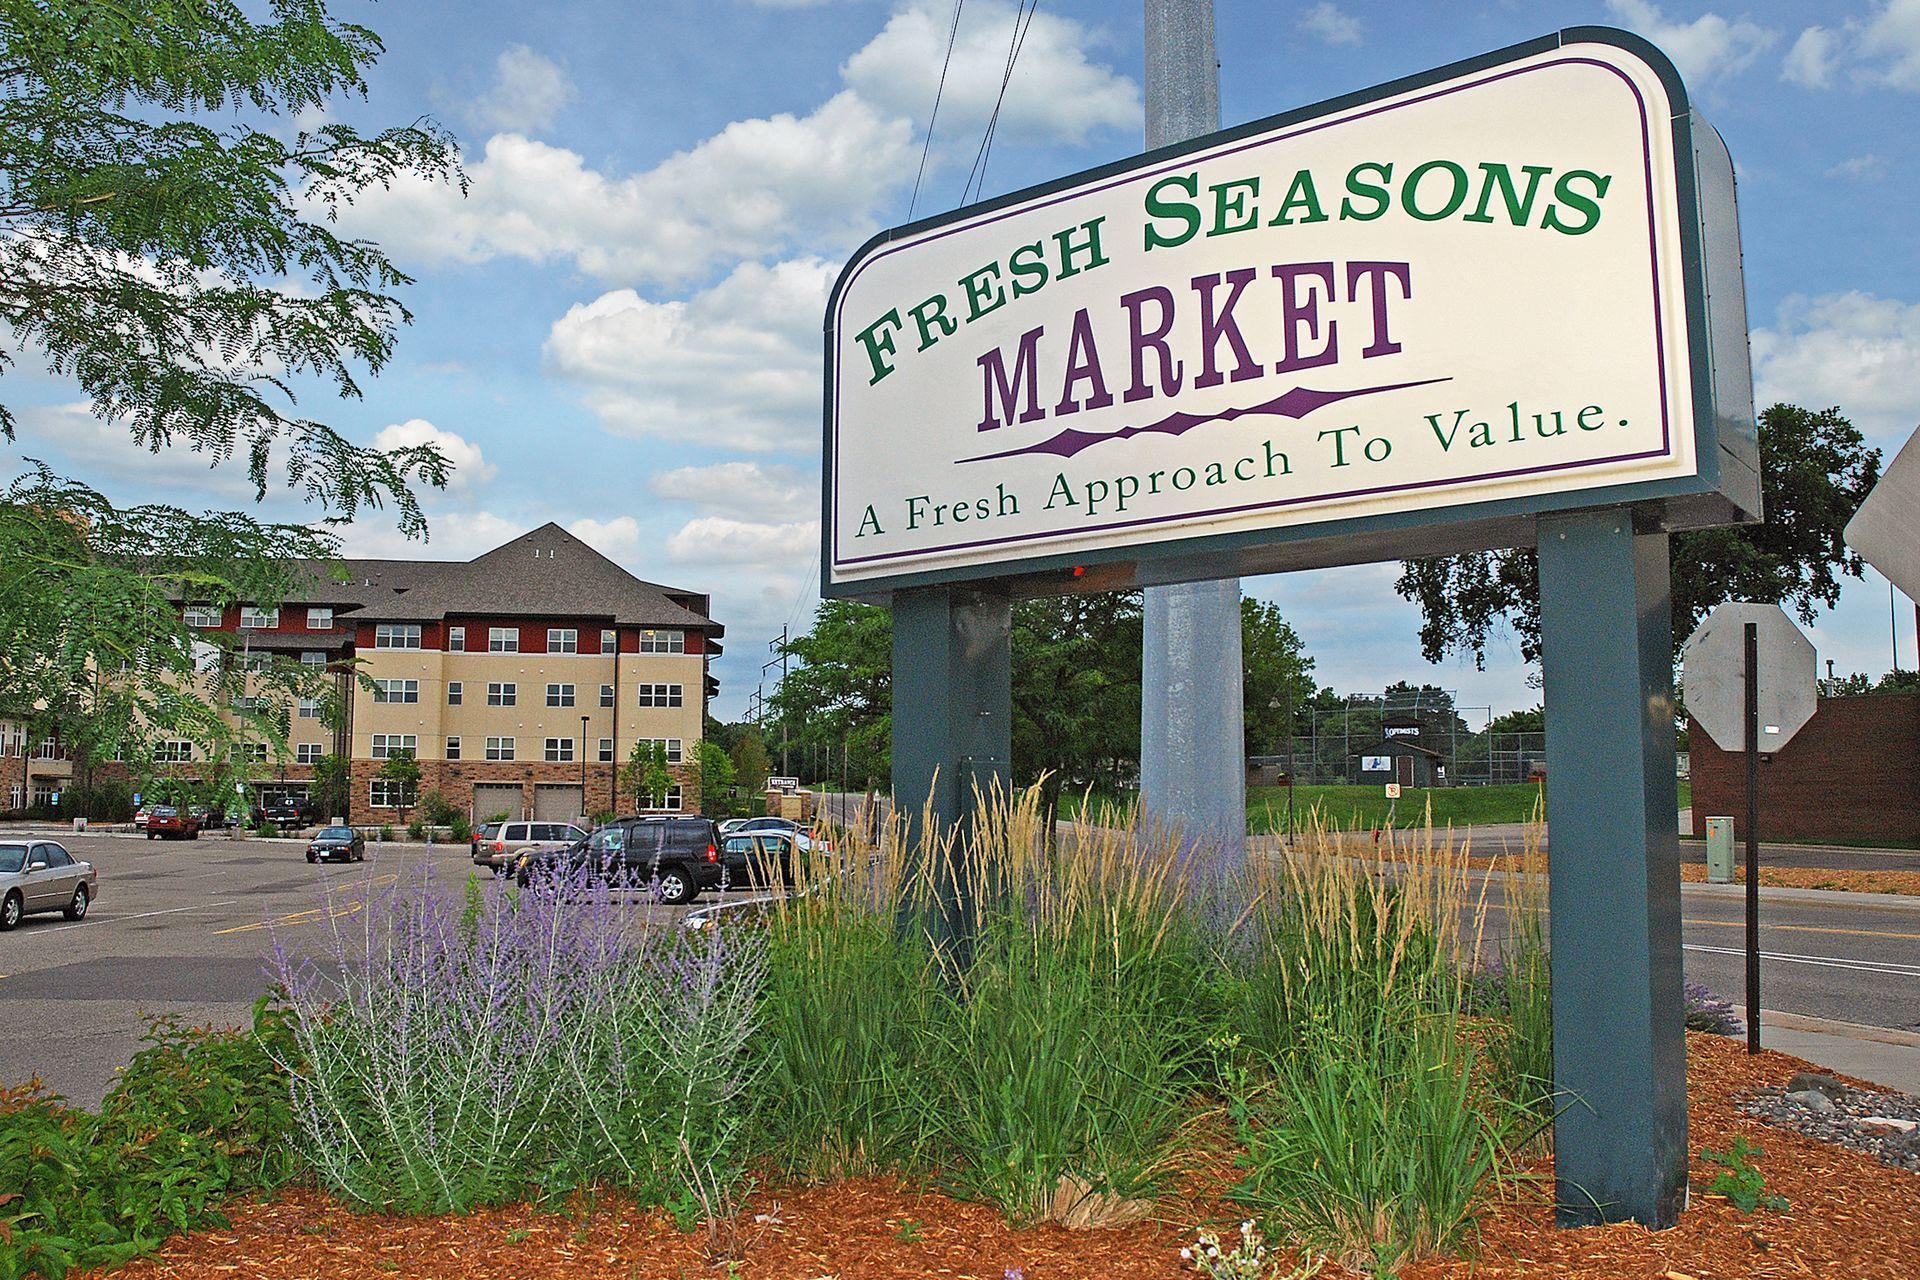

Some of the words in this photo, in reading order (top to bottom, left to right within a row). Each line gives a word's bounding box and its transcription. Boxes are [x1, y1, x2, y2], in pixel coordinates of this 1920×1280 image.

[854, 215, 1110, 387] FRESH
[1144, 159, 1613, 253] SEASONS
[976, 260, 1412, 433] MARKET
[854, 503, 886, 539] A
[904, 482, 1021, 531] Fresh
[1042, 439, 1294, 517] Approach
[1316, 425, 1392, 468] To
[1423, 401, 1628, 453] Value.
